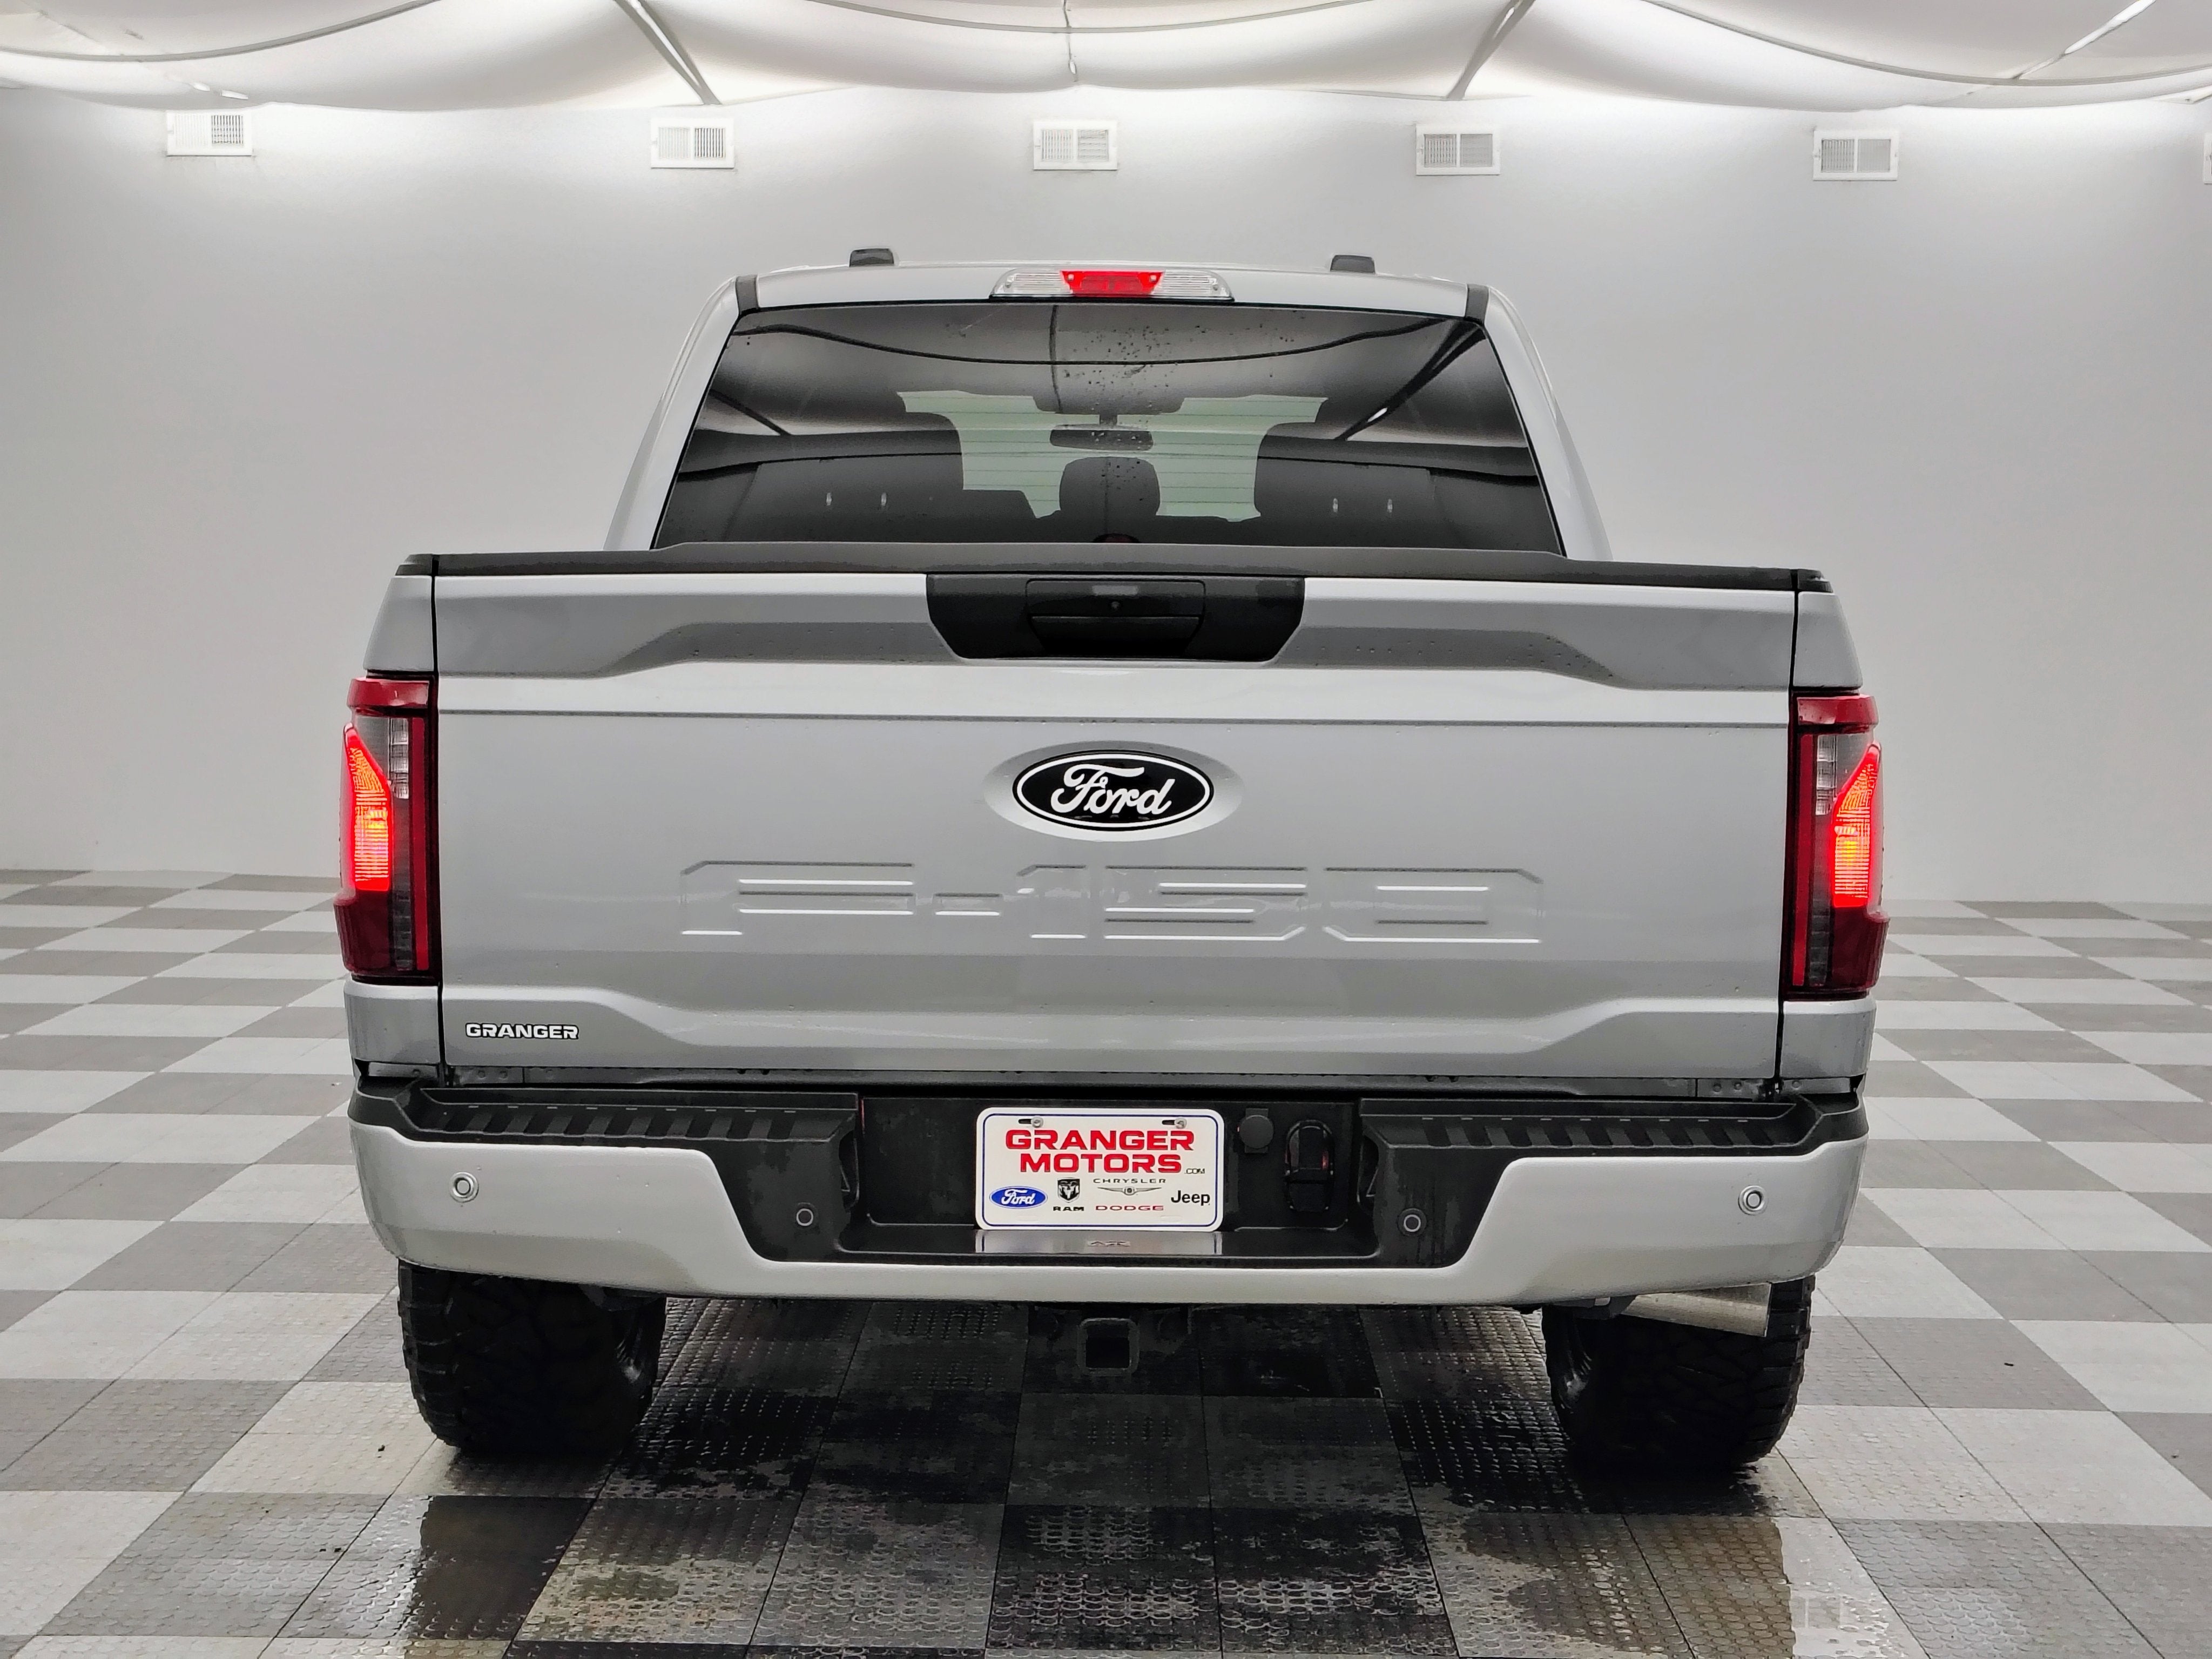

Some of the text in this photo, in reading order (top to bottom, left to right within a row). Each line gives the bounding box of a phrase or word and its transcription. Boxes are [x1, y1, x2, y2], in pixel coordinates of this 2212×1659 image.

[1051, 764, 1176, 815] Ford
[465, 1023, 579, 1039] GRANGER
[1006, 1129, 1194, 1151] GRANGER
[1020, 1154, 1182, 1174] MOTORS
[1001, 1189, 1035, 1205] Ford
[1170, 1190, 1211, 1206] Jeep
